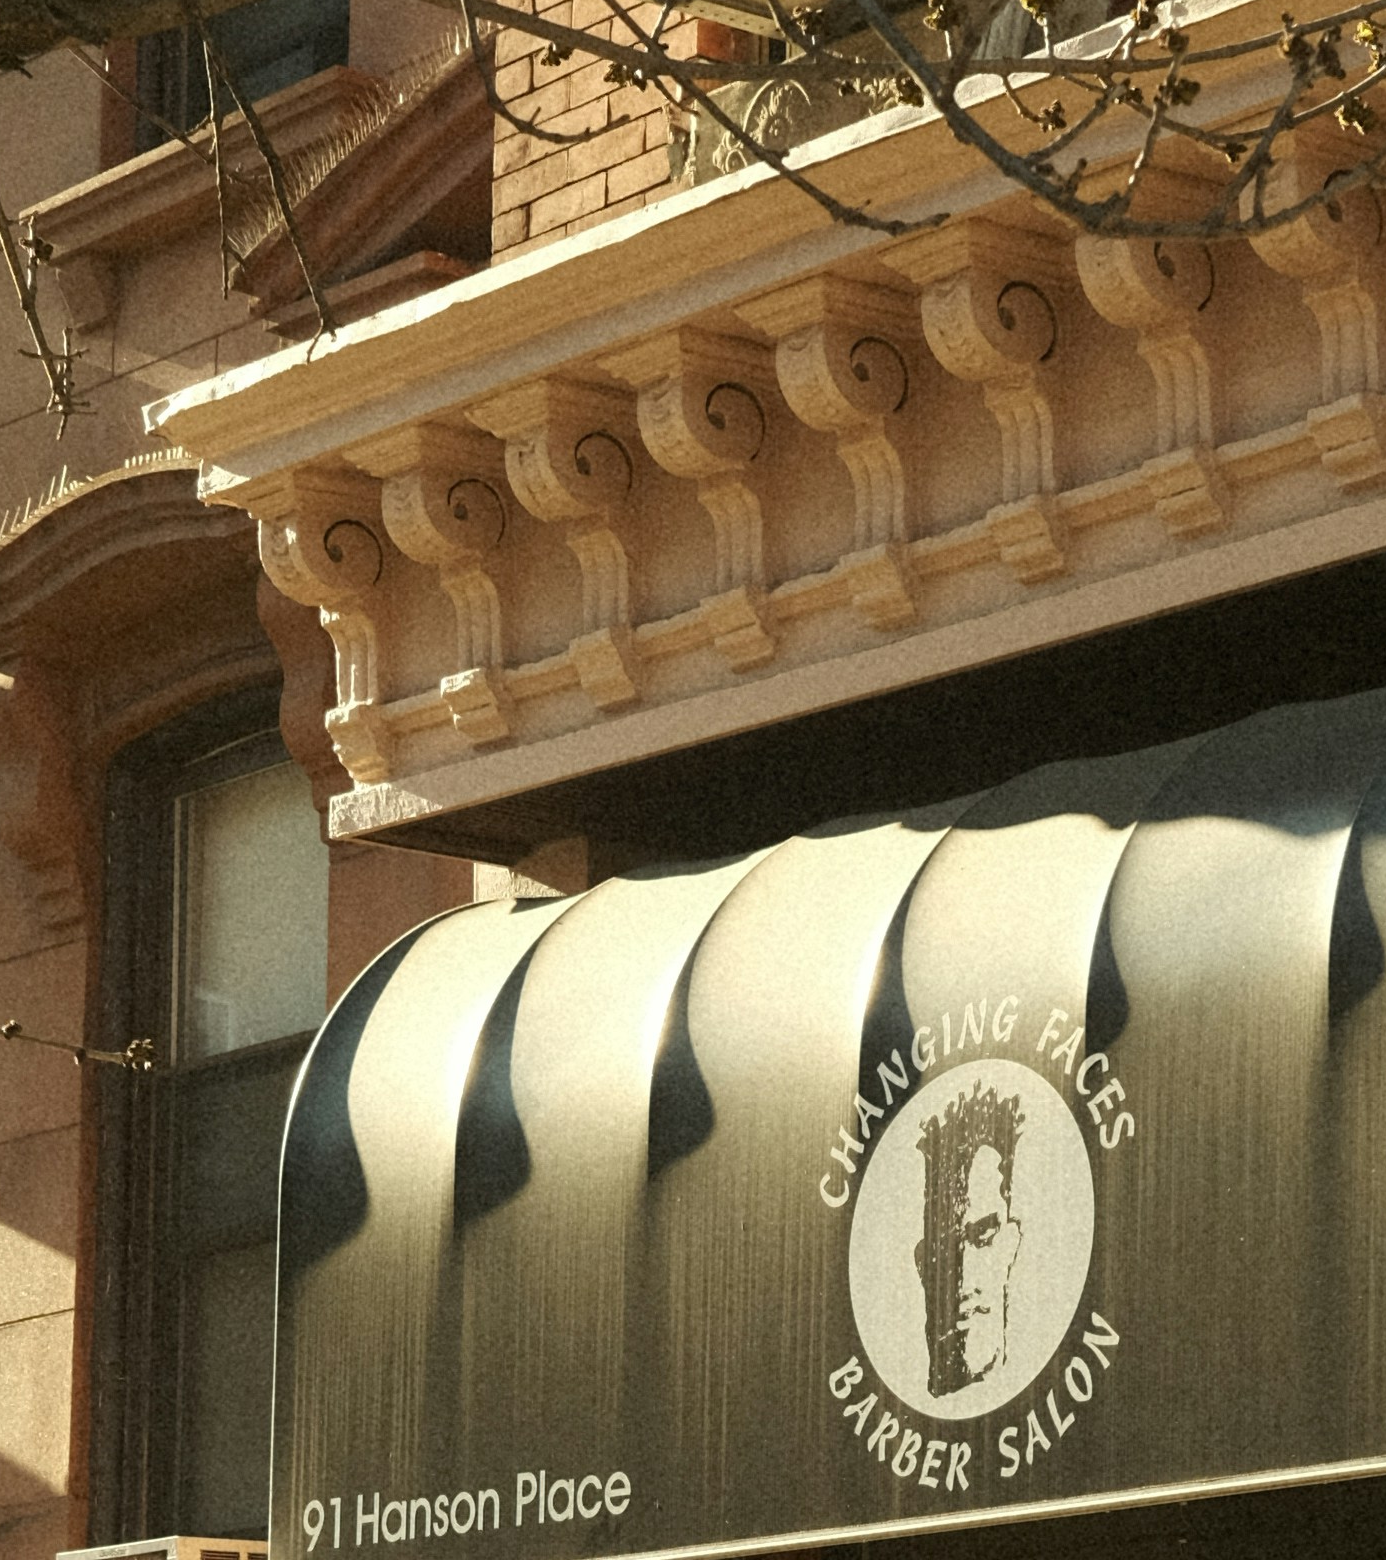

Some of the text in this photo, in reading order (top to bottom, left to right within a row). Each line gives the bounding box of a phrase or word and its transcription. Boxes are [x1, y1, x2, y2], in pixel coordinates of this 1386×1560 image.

[819, 995, 1135, 1208] CHANGING FACES
[829, 1312, 1121, 1491] BARBER SALON
[303, 1469, 632, 1552] 91 Hanson Place
